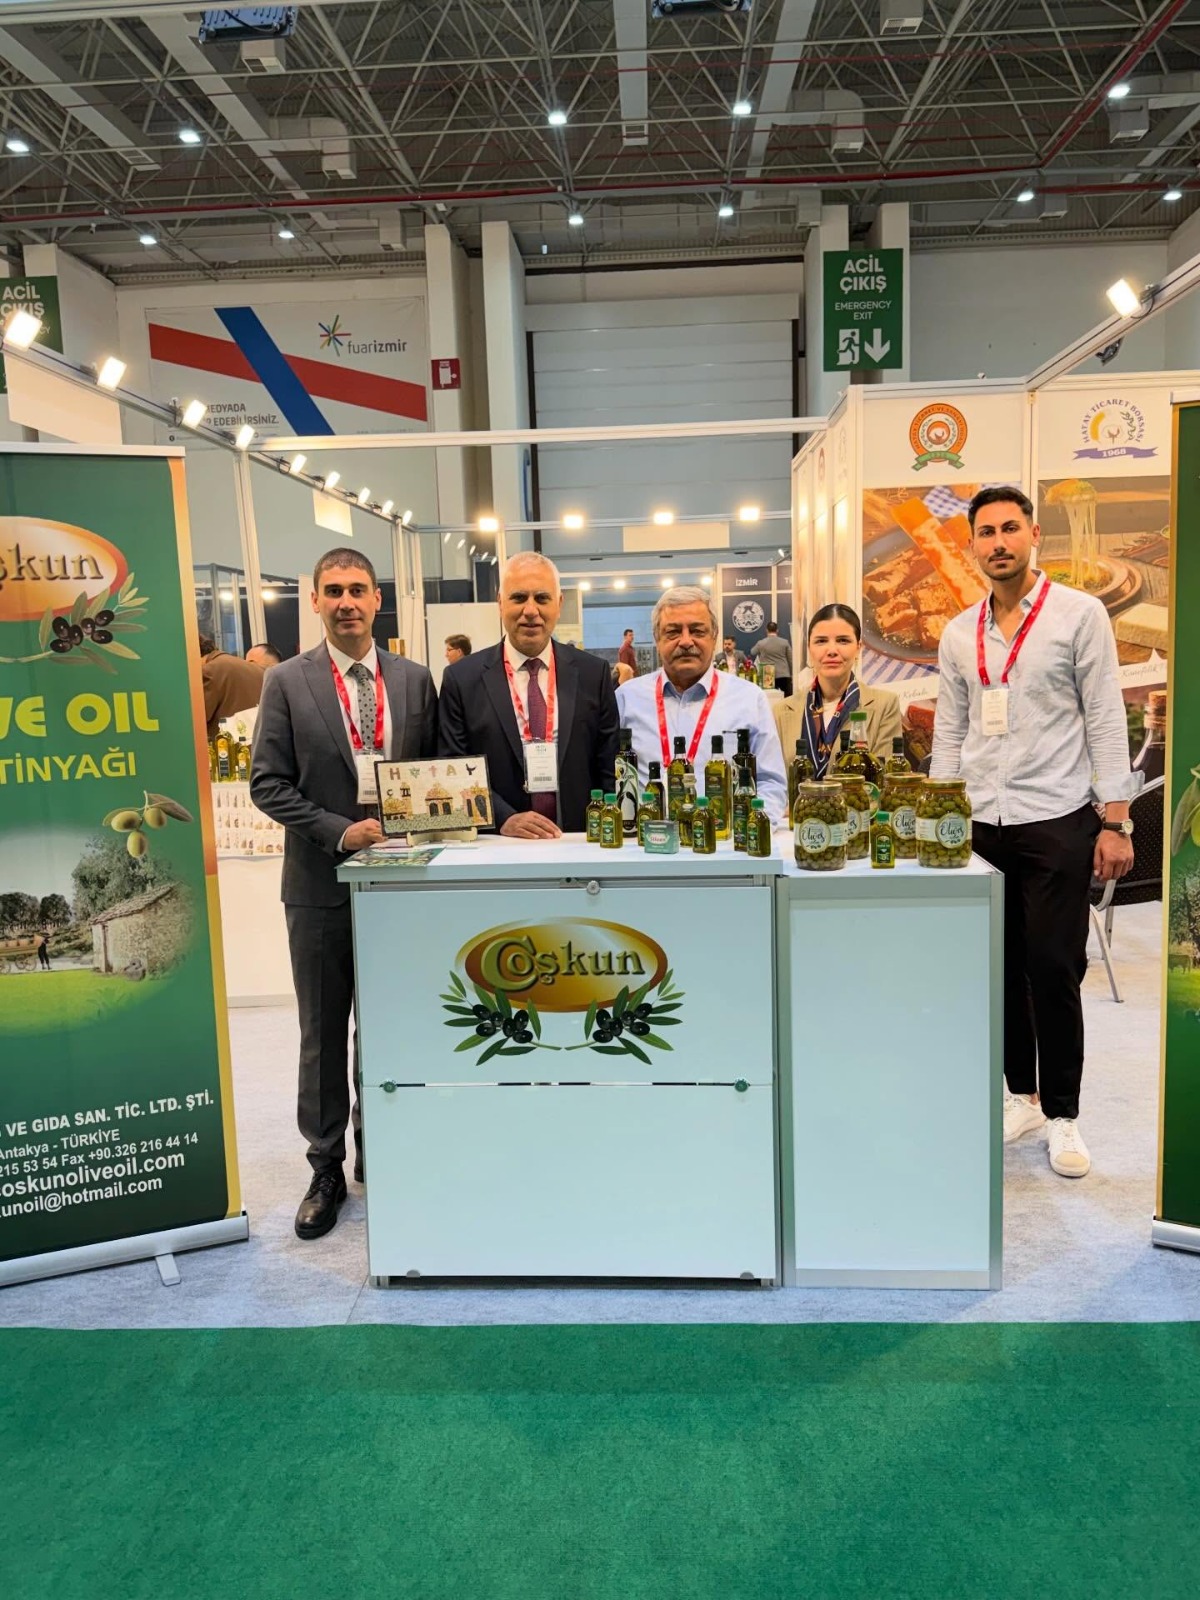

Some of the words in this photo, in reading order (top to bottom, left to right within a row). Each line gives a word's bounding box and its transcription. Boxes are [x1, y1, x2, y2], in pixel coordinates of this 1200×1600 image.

[843, 254, 884, 274] ACİL
[2, 281, 41, 301] ACİL
[839, 275, 887, 295] ÇIKIŞ
[834, 300, 892, 311] EMERGENCY
[853, 311, 874, 321] EXIT
[347, 339, 408, 354] fuarizmir
[1081, 414, 1092, 444] HATAY
[1130, 405, 1145, 443] BORSASI
[1101, 448, 1127, 458] 1968
[0, 542, 104, 591] kun
[735, 577, 759, 587] İZMİR
[66, 691, 160, 736] OIL
[480, 935, 646, 992] Coşkun
[5, 1121, 28, 1137] VE
[31, 1115, 71, 1133] GIDA
[74, 1108, 111, 1126] SAN.
[114, 1101, 146, 1119] TİC.
[149, 1097, 182, 1114] LTD.
[185, 1089, 214, 1111] ŞTİ.
[60, 1129, 121, 1149] TÜRKİYE
[23, 1160, 39, 1173] 53
[42, 1156, 58, 1170] 54
[61, 1153, 85, 1166] Fax
[88, 1143, 137, 1161] +90.326
[140, 1138, 163, 1153] 216
[165, 1135, 180, 1149] 44
[183, 1132, 199, 1145] 14
[0, 1153, 185, 1197] oskunoliveoil.com
[0, 1178, 162, 1218] unoil@hotmail.com
